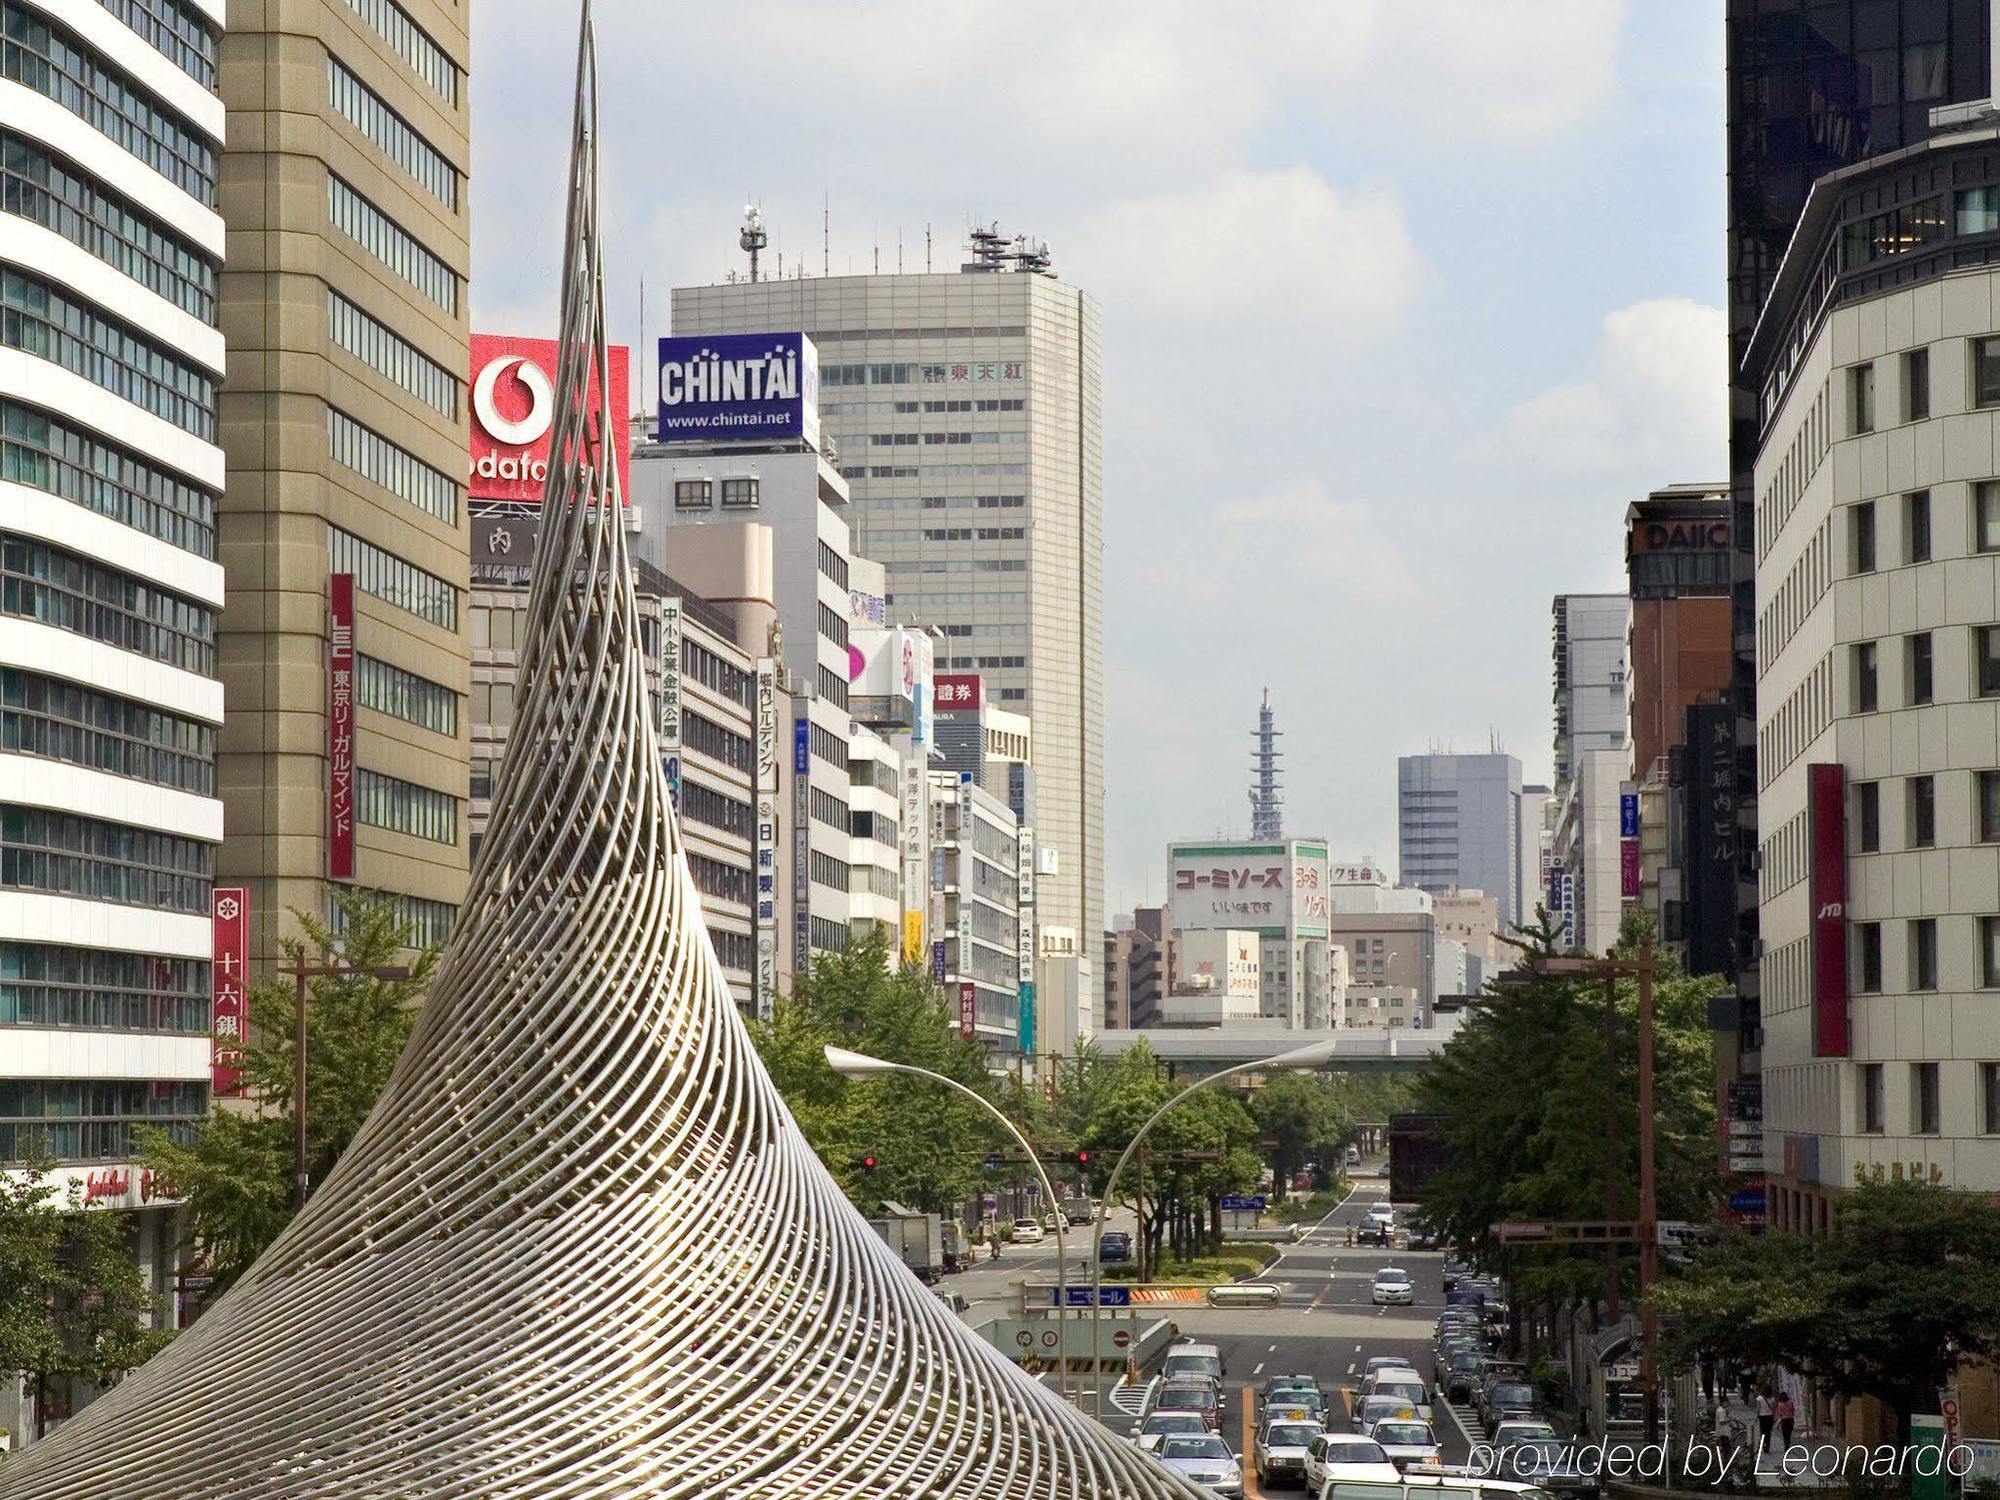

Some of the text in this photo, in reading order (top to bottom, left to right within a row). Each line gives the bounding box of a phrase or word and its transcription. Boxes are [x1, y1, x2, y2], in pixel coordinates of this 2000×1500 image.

[951, 363, 1022, 381] 東天紅
[667, 412, 791, 428] www.chintai.net
[332, 615, 351, 658] LEC
[663, 607, 679, 739] 中小企業金融公庫
[931, 684, 972, 701] 證券
[759, 673, 774, 777] 堀内ビルディング
[333, 669, 351, 837] 東京リーガルマインド
[1176, 867, 1283, 890] コーミソース
[1330, 867, 1372, 881] ク生命
[1817, 902, 1842, 919] JTB
[215, 952, 240, 1064] 十六銀行
